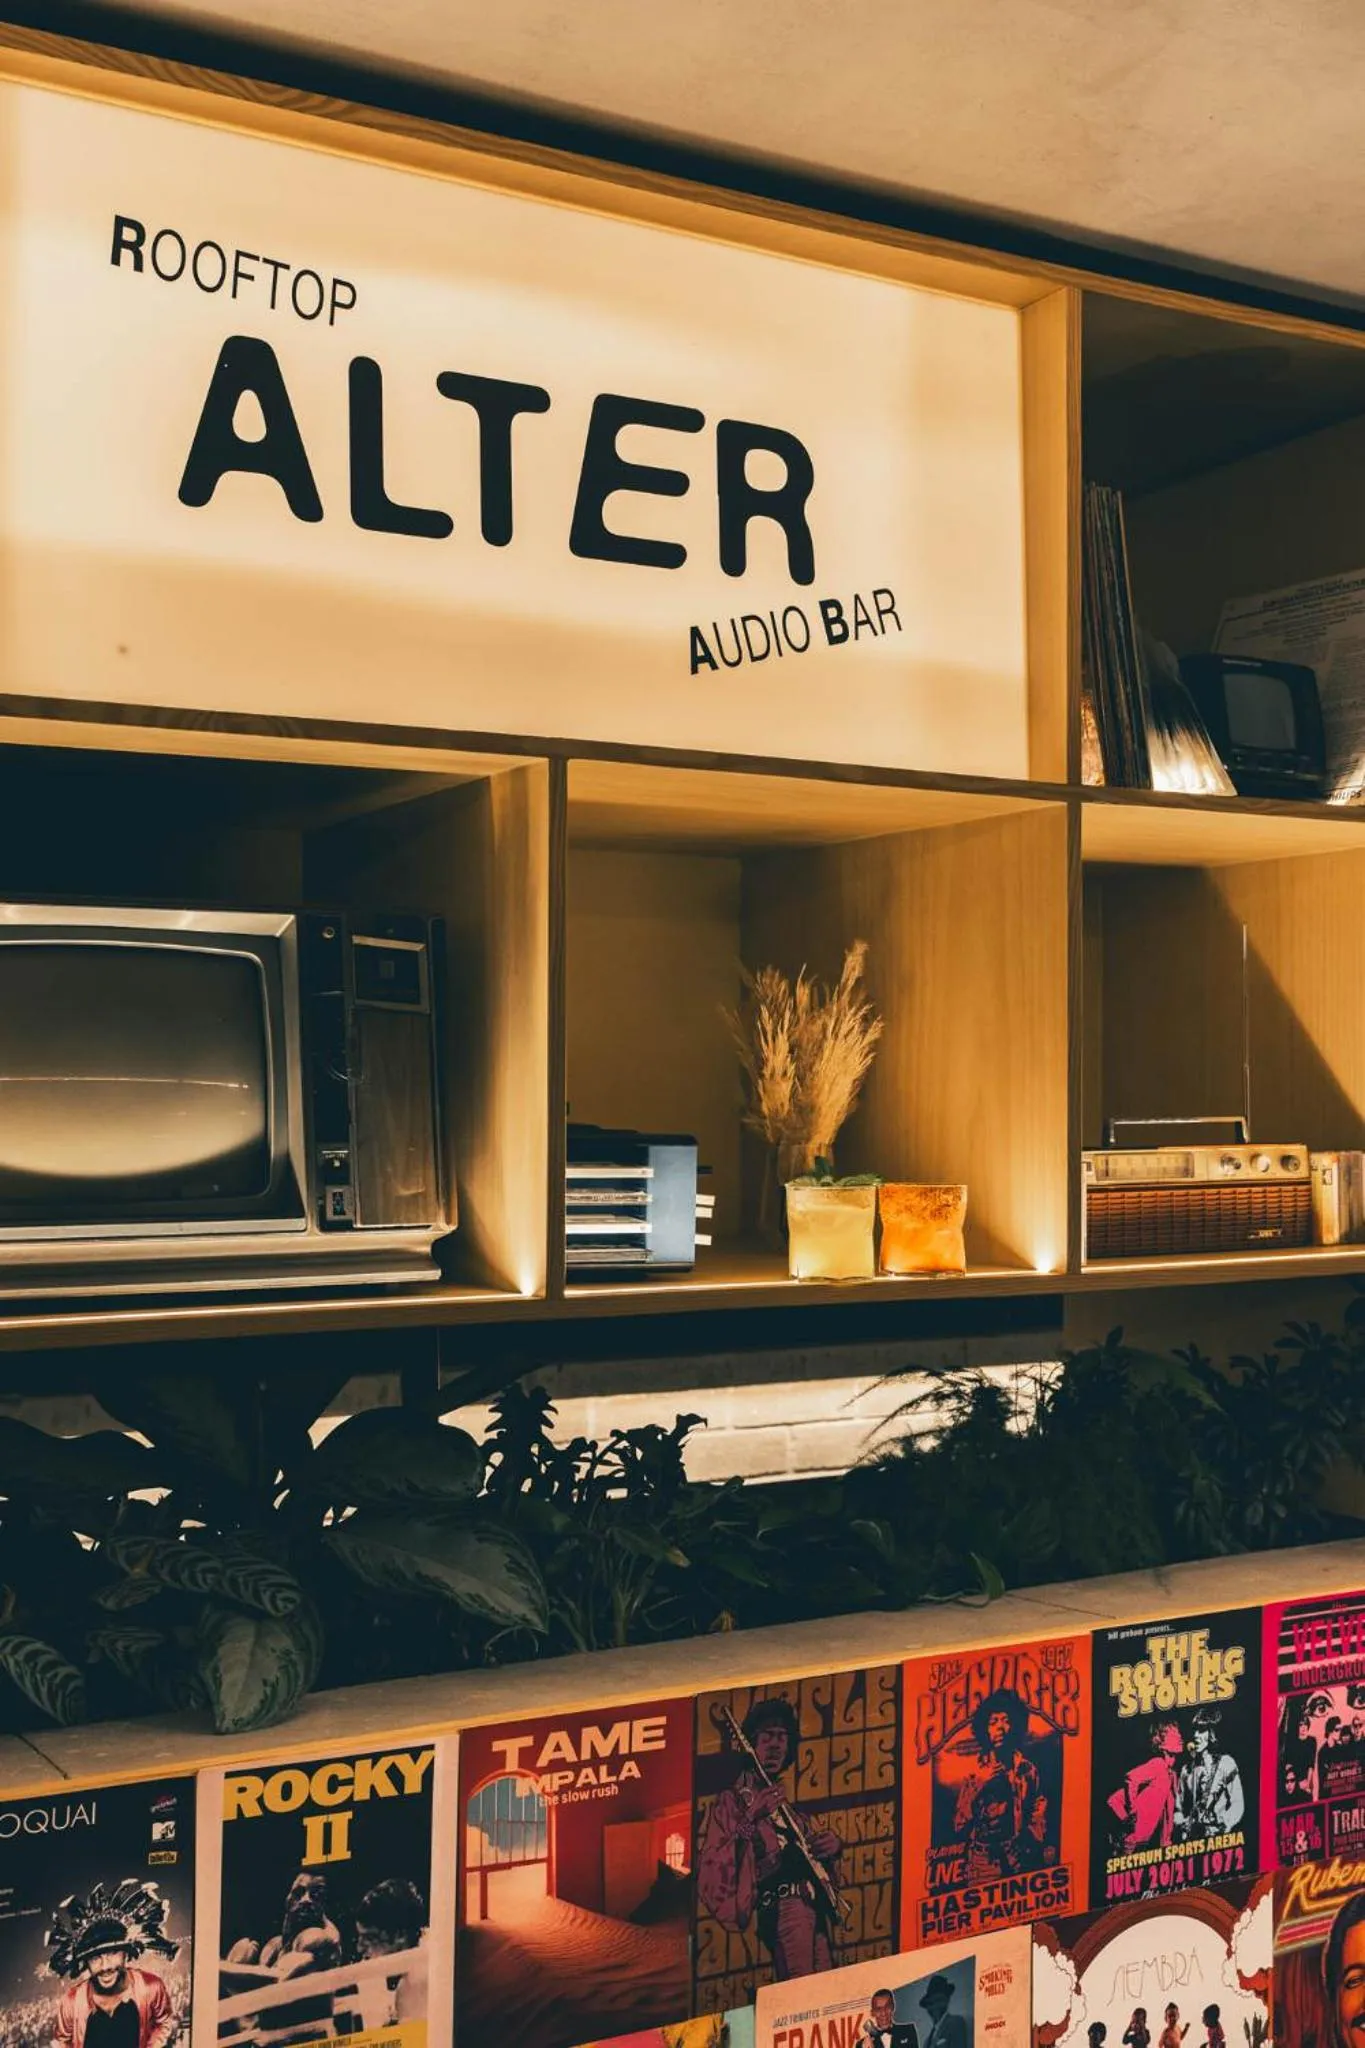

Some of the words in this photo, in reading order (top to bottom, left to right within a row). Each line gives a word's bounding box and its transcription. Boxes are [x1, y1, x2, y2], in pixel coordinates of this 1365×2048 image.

[111, 215, 357, 326] ROOFTOP
[178, 335, 816, 586] ALTER
[690, 606, 810, 675] AUDIO
[819, 588, 902, 646] BAR
[1110, 1645, 1246, 1696] ROLLING
[1147, 1628, 1210, 1664] THE
[697, 1666, 897, 1756] PUPLE
[915, 1653, 1081, 1766] HENDRIX
[1118, 1672, 1237, 1718] STONES
[492, 1716, 667, 1772] TAME
[778, 1726, 897, 1805] AZE
[223, 1750, 435, 1821] ROCKY
[515, 1760, 642, 1798] IMPALA
[539, 1794, 559, 1808] the
[562, 1789, 591, 1804] slow
[592, 1784, 619, 1797] rush
[302, 1811, 353, 1866] II
[1106, 1847, 1162, 1873] SPECTRUM
[1165, 1839, 1205, 1860] SPORTS
[1206, 1831, 1245, 1851] ARENA
[921, 1867, 1070, 1922] HASTINGS
[925, 1856, 966, 1891] LIVE
[1106, 1868, 1144, 1898] JULY
[1149, 1856, 1195, 1888] 20/21
[1203, 1846, 1245, 1877] 1972
[922, 1911, 972, 1938] PIER
[979, 1888, 1070, 1924] PAVILION
